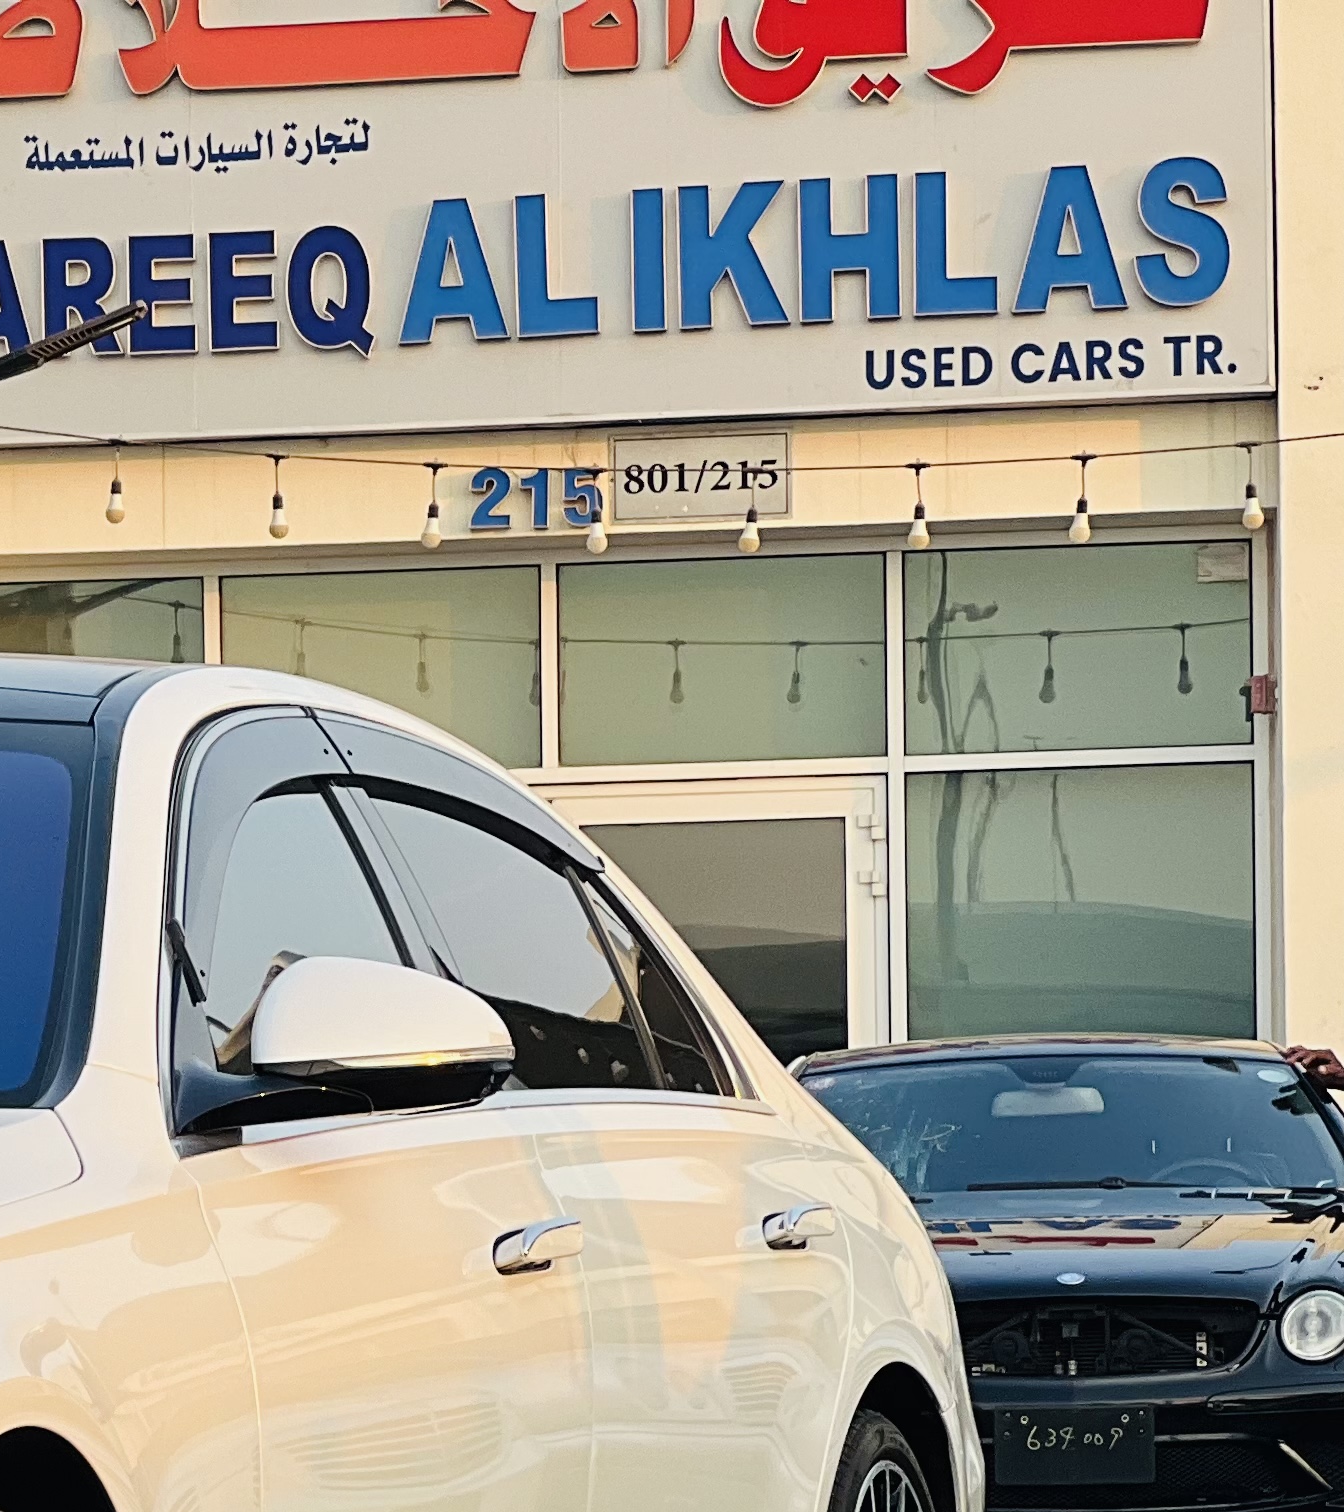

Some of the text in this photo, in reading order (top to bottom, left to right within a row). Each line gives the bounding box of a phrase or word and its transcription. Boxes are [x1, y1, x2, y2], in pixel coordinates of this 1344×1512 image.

[23, 117, 372, 173] لتجارة السيارات المستعملة
[398, 193, 600, 346] AL
[629, 155, 1232, 334] IKHLAS
[864, 334, 1238, 391] USED CARS TR.
[468, 466, 604, 530] 215
[622, 459, 779, 495] 801/215
